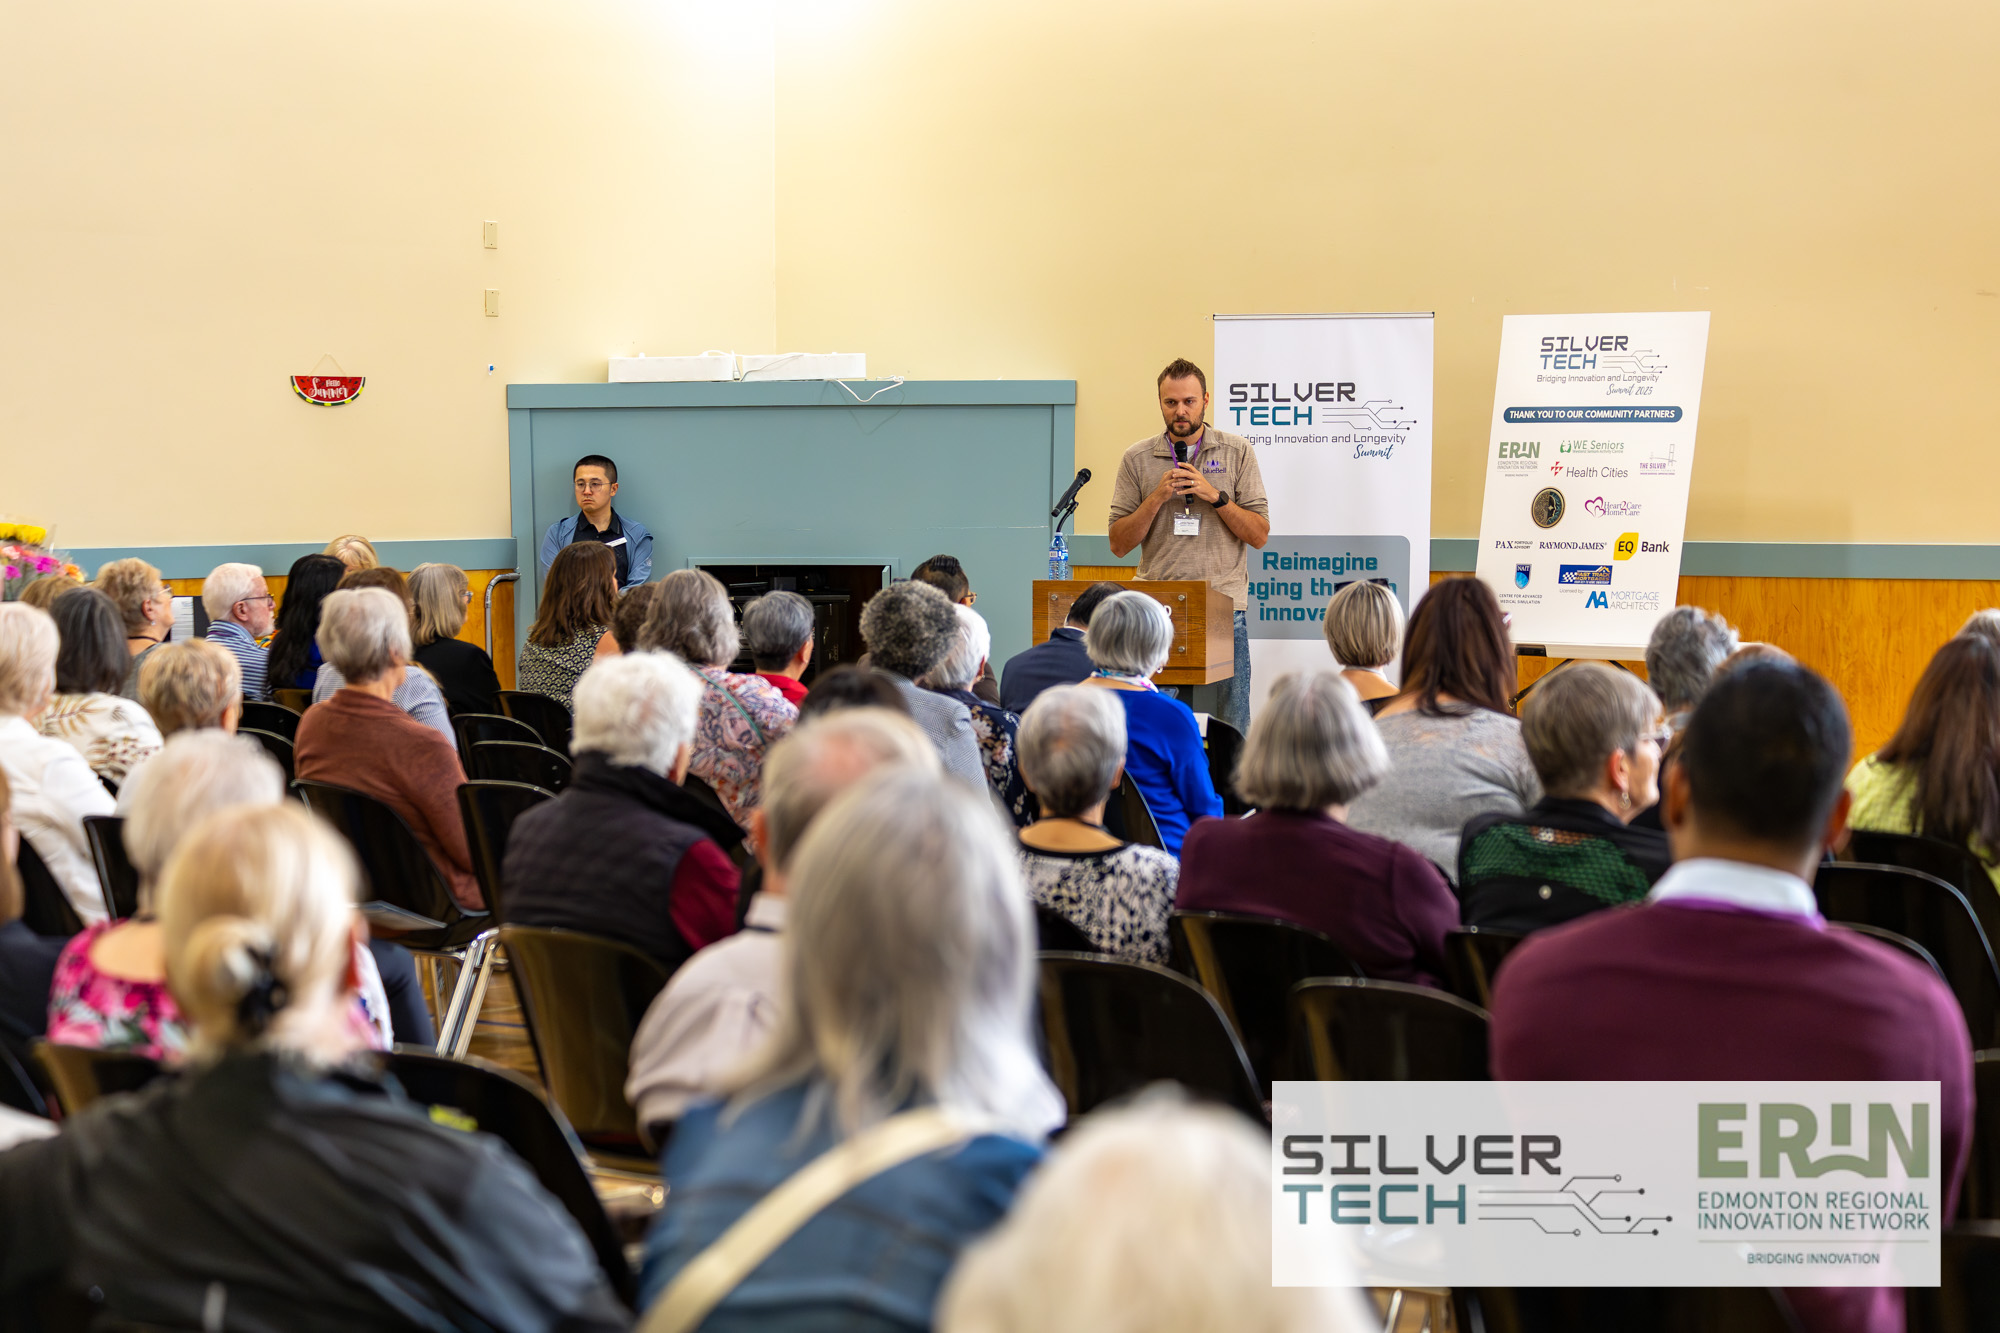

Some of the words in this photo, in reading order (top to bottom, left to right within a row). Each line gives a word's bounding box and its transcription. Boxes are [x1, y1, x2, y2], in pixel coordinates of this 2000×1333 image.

[1541, 336, 1628, 352] SILVER
[1540, 354, 1597, 369] TECH
[1537, 374, 1567, 384] Bridging
[1568, 374, 1605, 382] Innovation
[1607, 374, 1621, 382] and
[1622, 374, 1659, 383] Longevity
[1229, 382, 1356, 403] SILVER
[1606, 383, 1635, 396] Summit
[1635, 386, 1653, 395] 2025
[1229, 406, 1313, 426] TECH
[1509, 410, 1536, 419] THANK
[1537, 410, 1554, 419] YOU
[1555, 410, 1565, 419] TO
[1566, 410, 1584, 419] OUR
[1585, 410, 1633, 419] COMMUNITY
[1634, 409, 1675, 418] PARTNERS
[1241, 434, 1272, 446] ging
[1274, 434, 1328, 443] Innovation
[1331, 434, 1351, 443] and
[1353, 434, 1406, 445] Longevity
[1573, 440, 1588, 449] WE
[1590, 440, 1625, 450] Seniors
[1353, 444, 1394, 460] Summit
[1498, 441, 1541, 459] ERIN
[1566, 467, 1598, 478] Health
[1601, 467, 1629, 478] Cities
[1625, 509, 1641, 517] Care
[1495, 540, 1514, 549] PAX
[1539, 541, 1579, 550] RAYMOND
[1618, 541, 1634, 553] EQ
[1641, 541, 1670, 553] Bank
[1262, 552, 1378, 575] Reimagine
[1248, 577, 1302, 600] aging
[1611, 591, 1659, 601] MORTGAGE
[1610, 602, 1659, 611] ARCHITECTS
